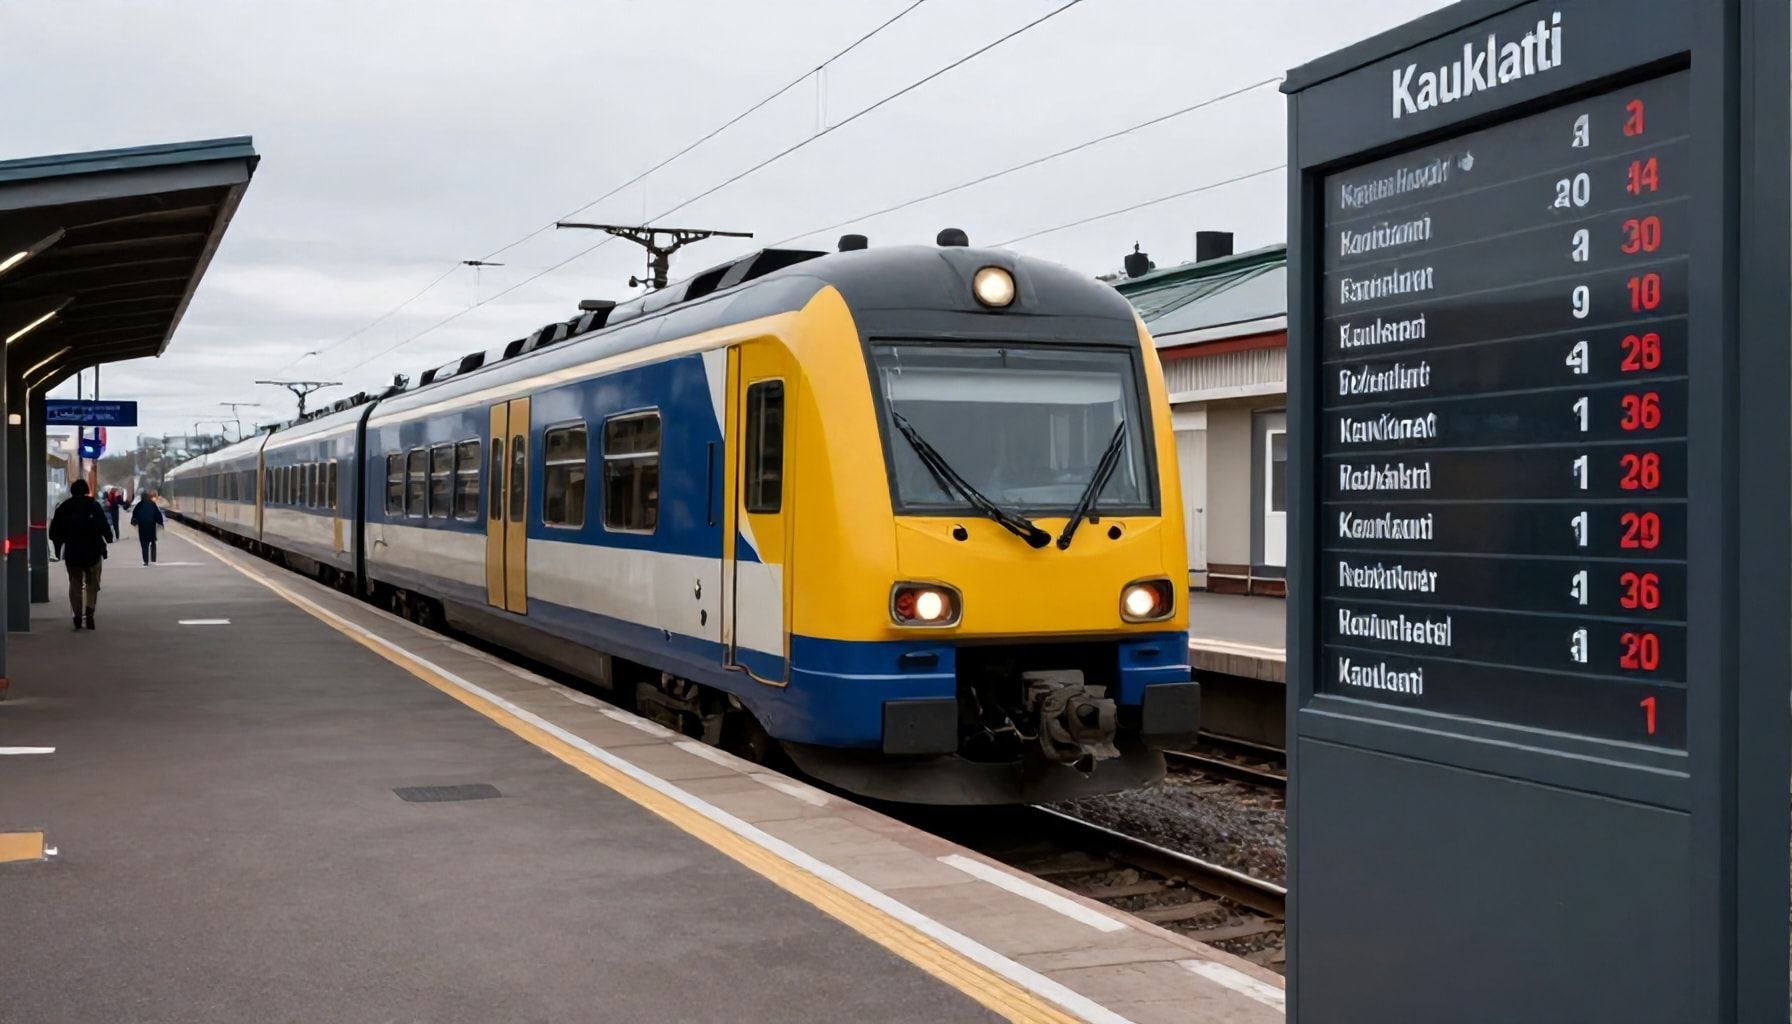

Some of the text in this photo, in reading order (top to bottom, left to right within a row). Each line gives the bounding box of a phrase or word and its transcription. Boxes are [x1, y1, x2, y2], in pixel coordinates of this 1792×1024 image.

[1392, 11, 1563, 119] Kauklatti
[1571, 273, 1662, 319] 9 10
[1572, 391, 1662, 432] 1 36
[1619, 571, 1661, 610] 36
[1619, 632, 1660, 671] 20
[1640, 695, 1657, 734] 1
